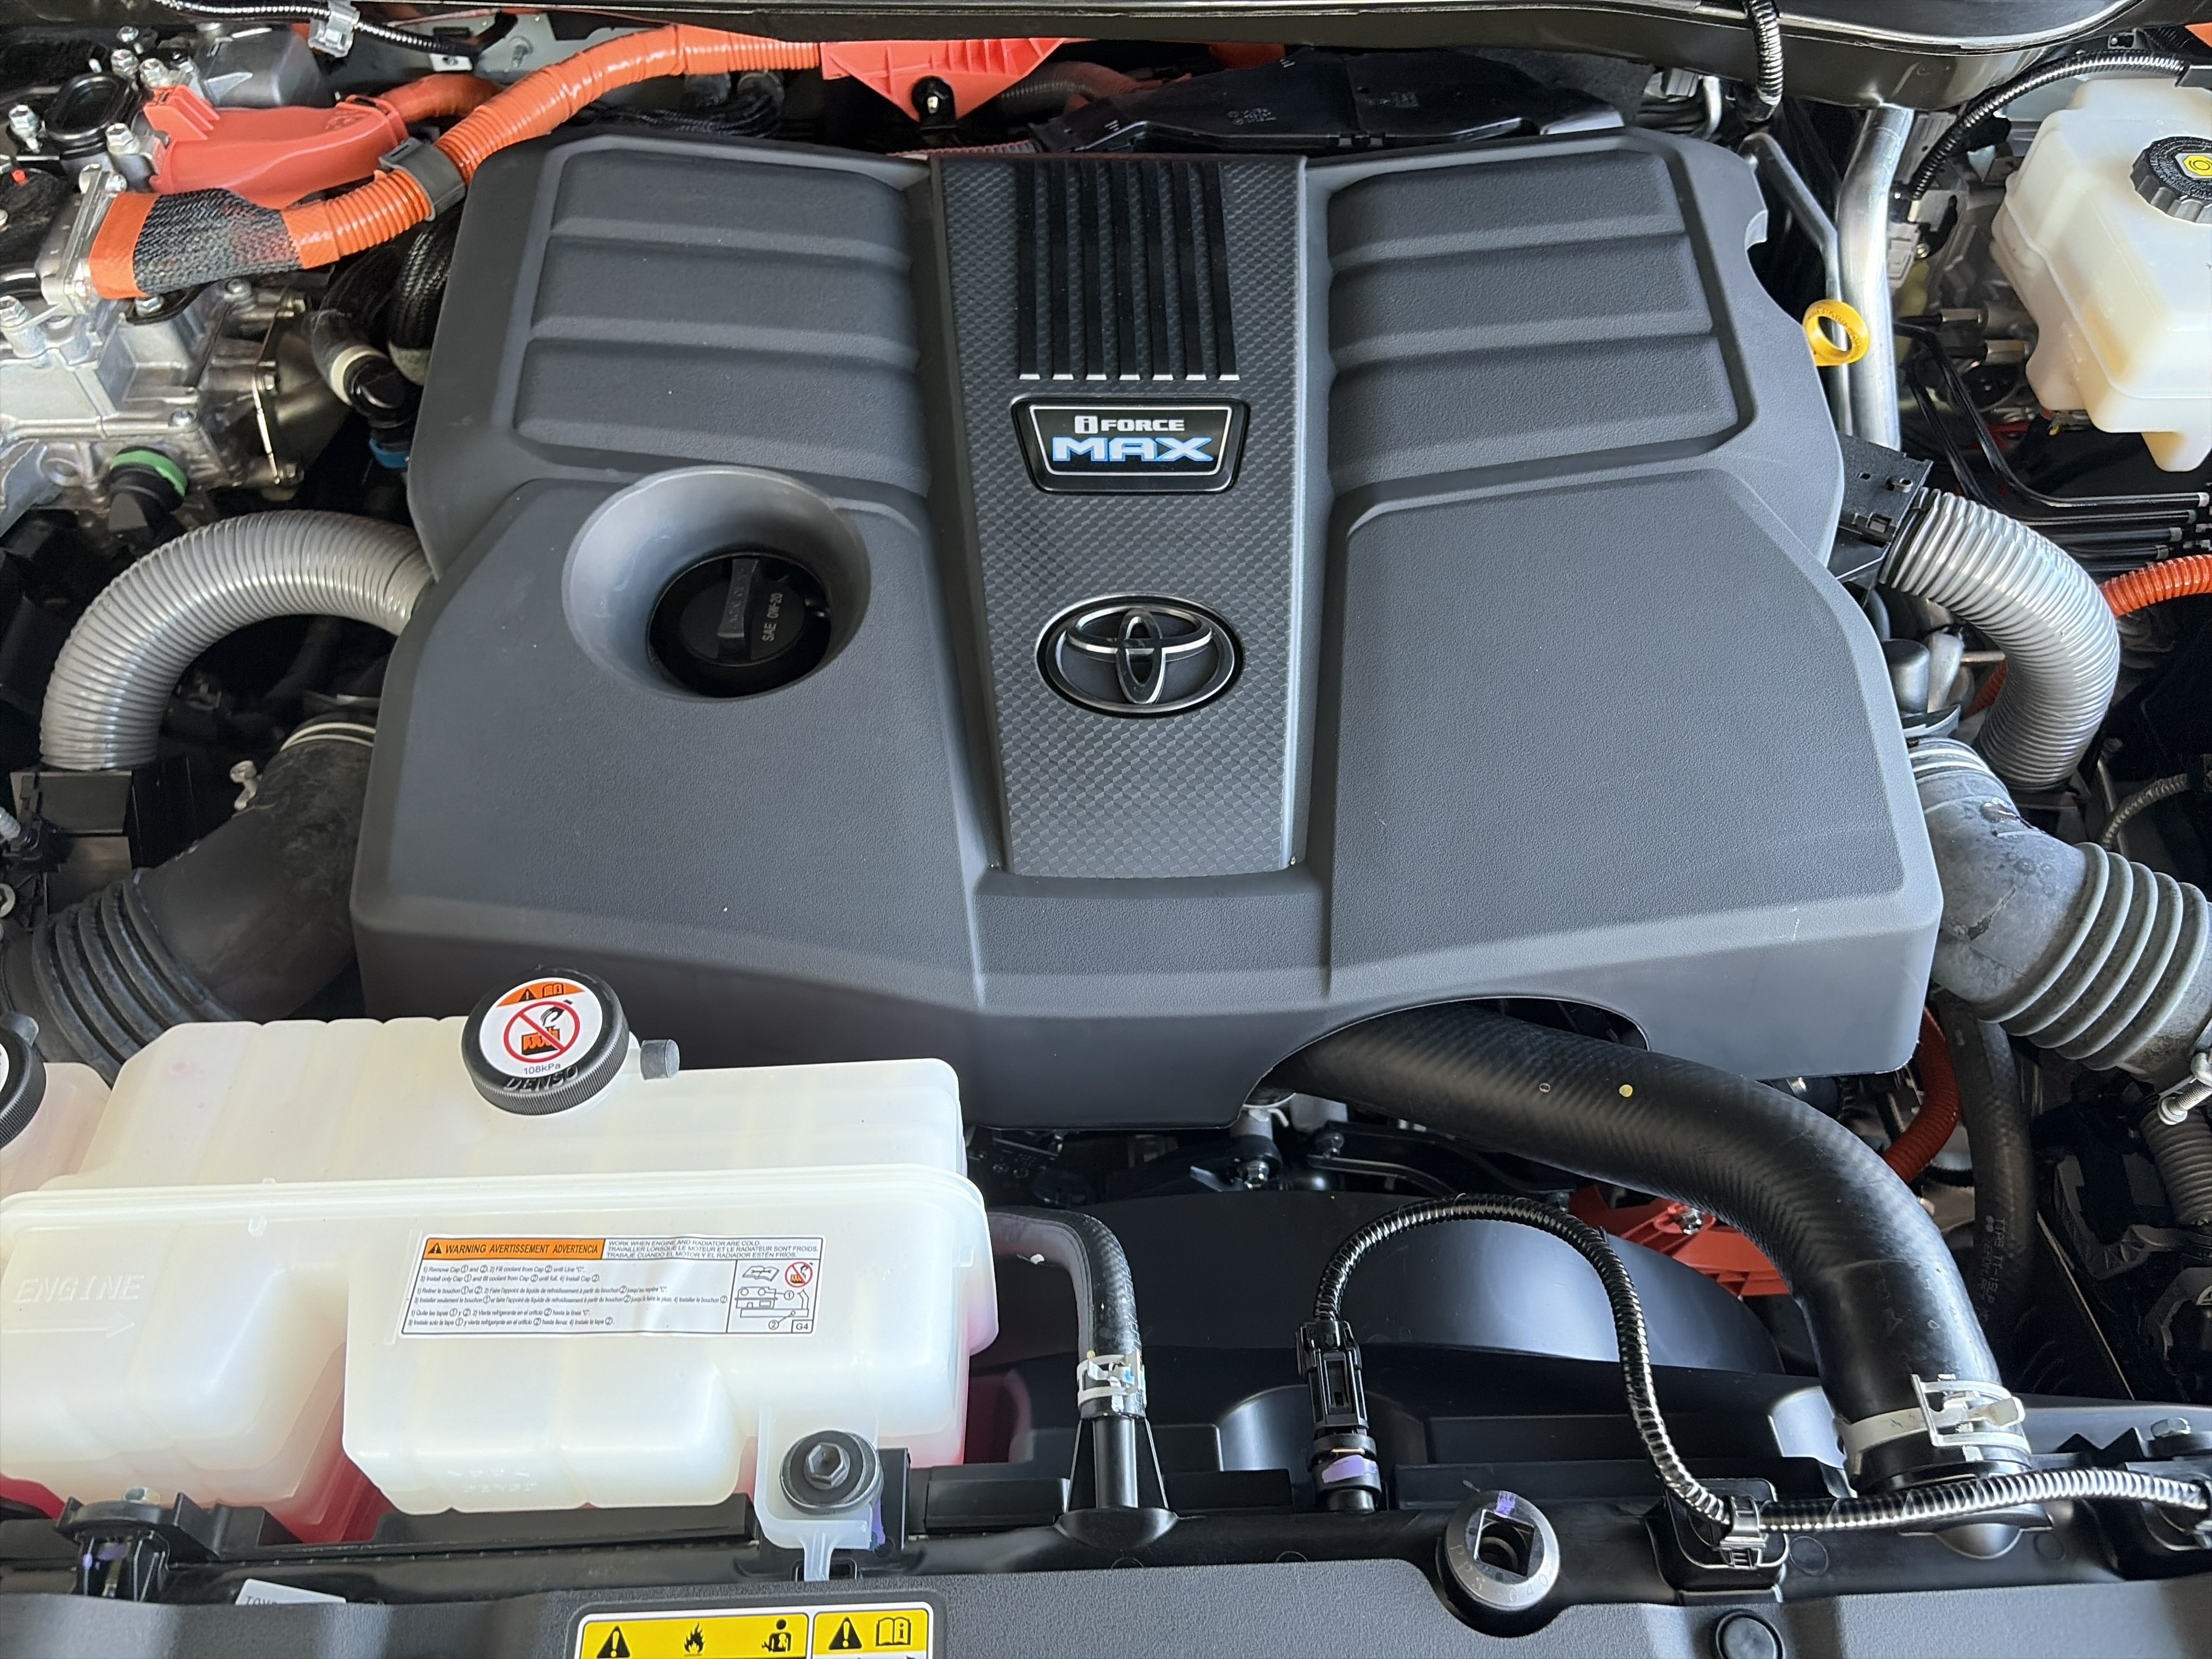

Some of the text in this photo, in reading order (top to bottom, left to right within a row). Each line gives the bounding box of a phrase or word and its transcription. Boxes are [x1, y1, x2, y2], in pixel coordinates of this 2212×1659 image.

[1101, 419, 1185, 431] FORCE
[1052, 437, 1214, 462] MAX
[761, 622, 777, 641] SAE
[504, 1065, 578, 1092] DENSO
[523, 1063, 561, 1075] 108kPa
[445, 1244, 598, 1254] WARNING AVERTISSEMENT ADVERTENCIA
[13, 1274, 145, 1304] ENGINE
